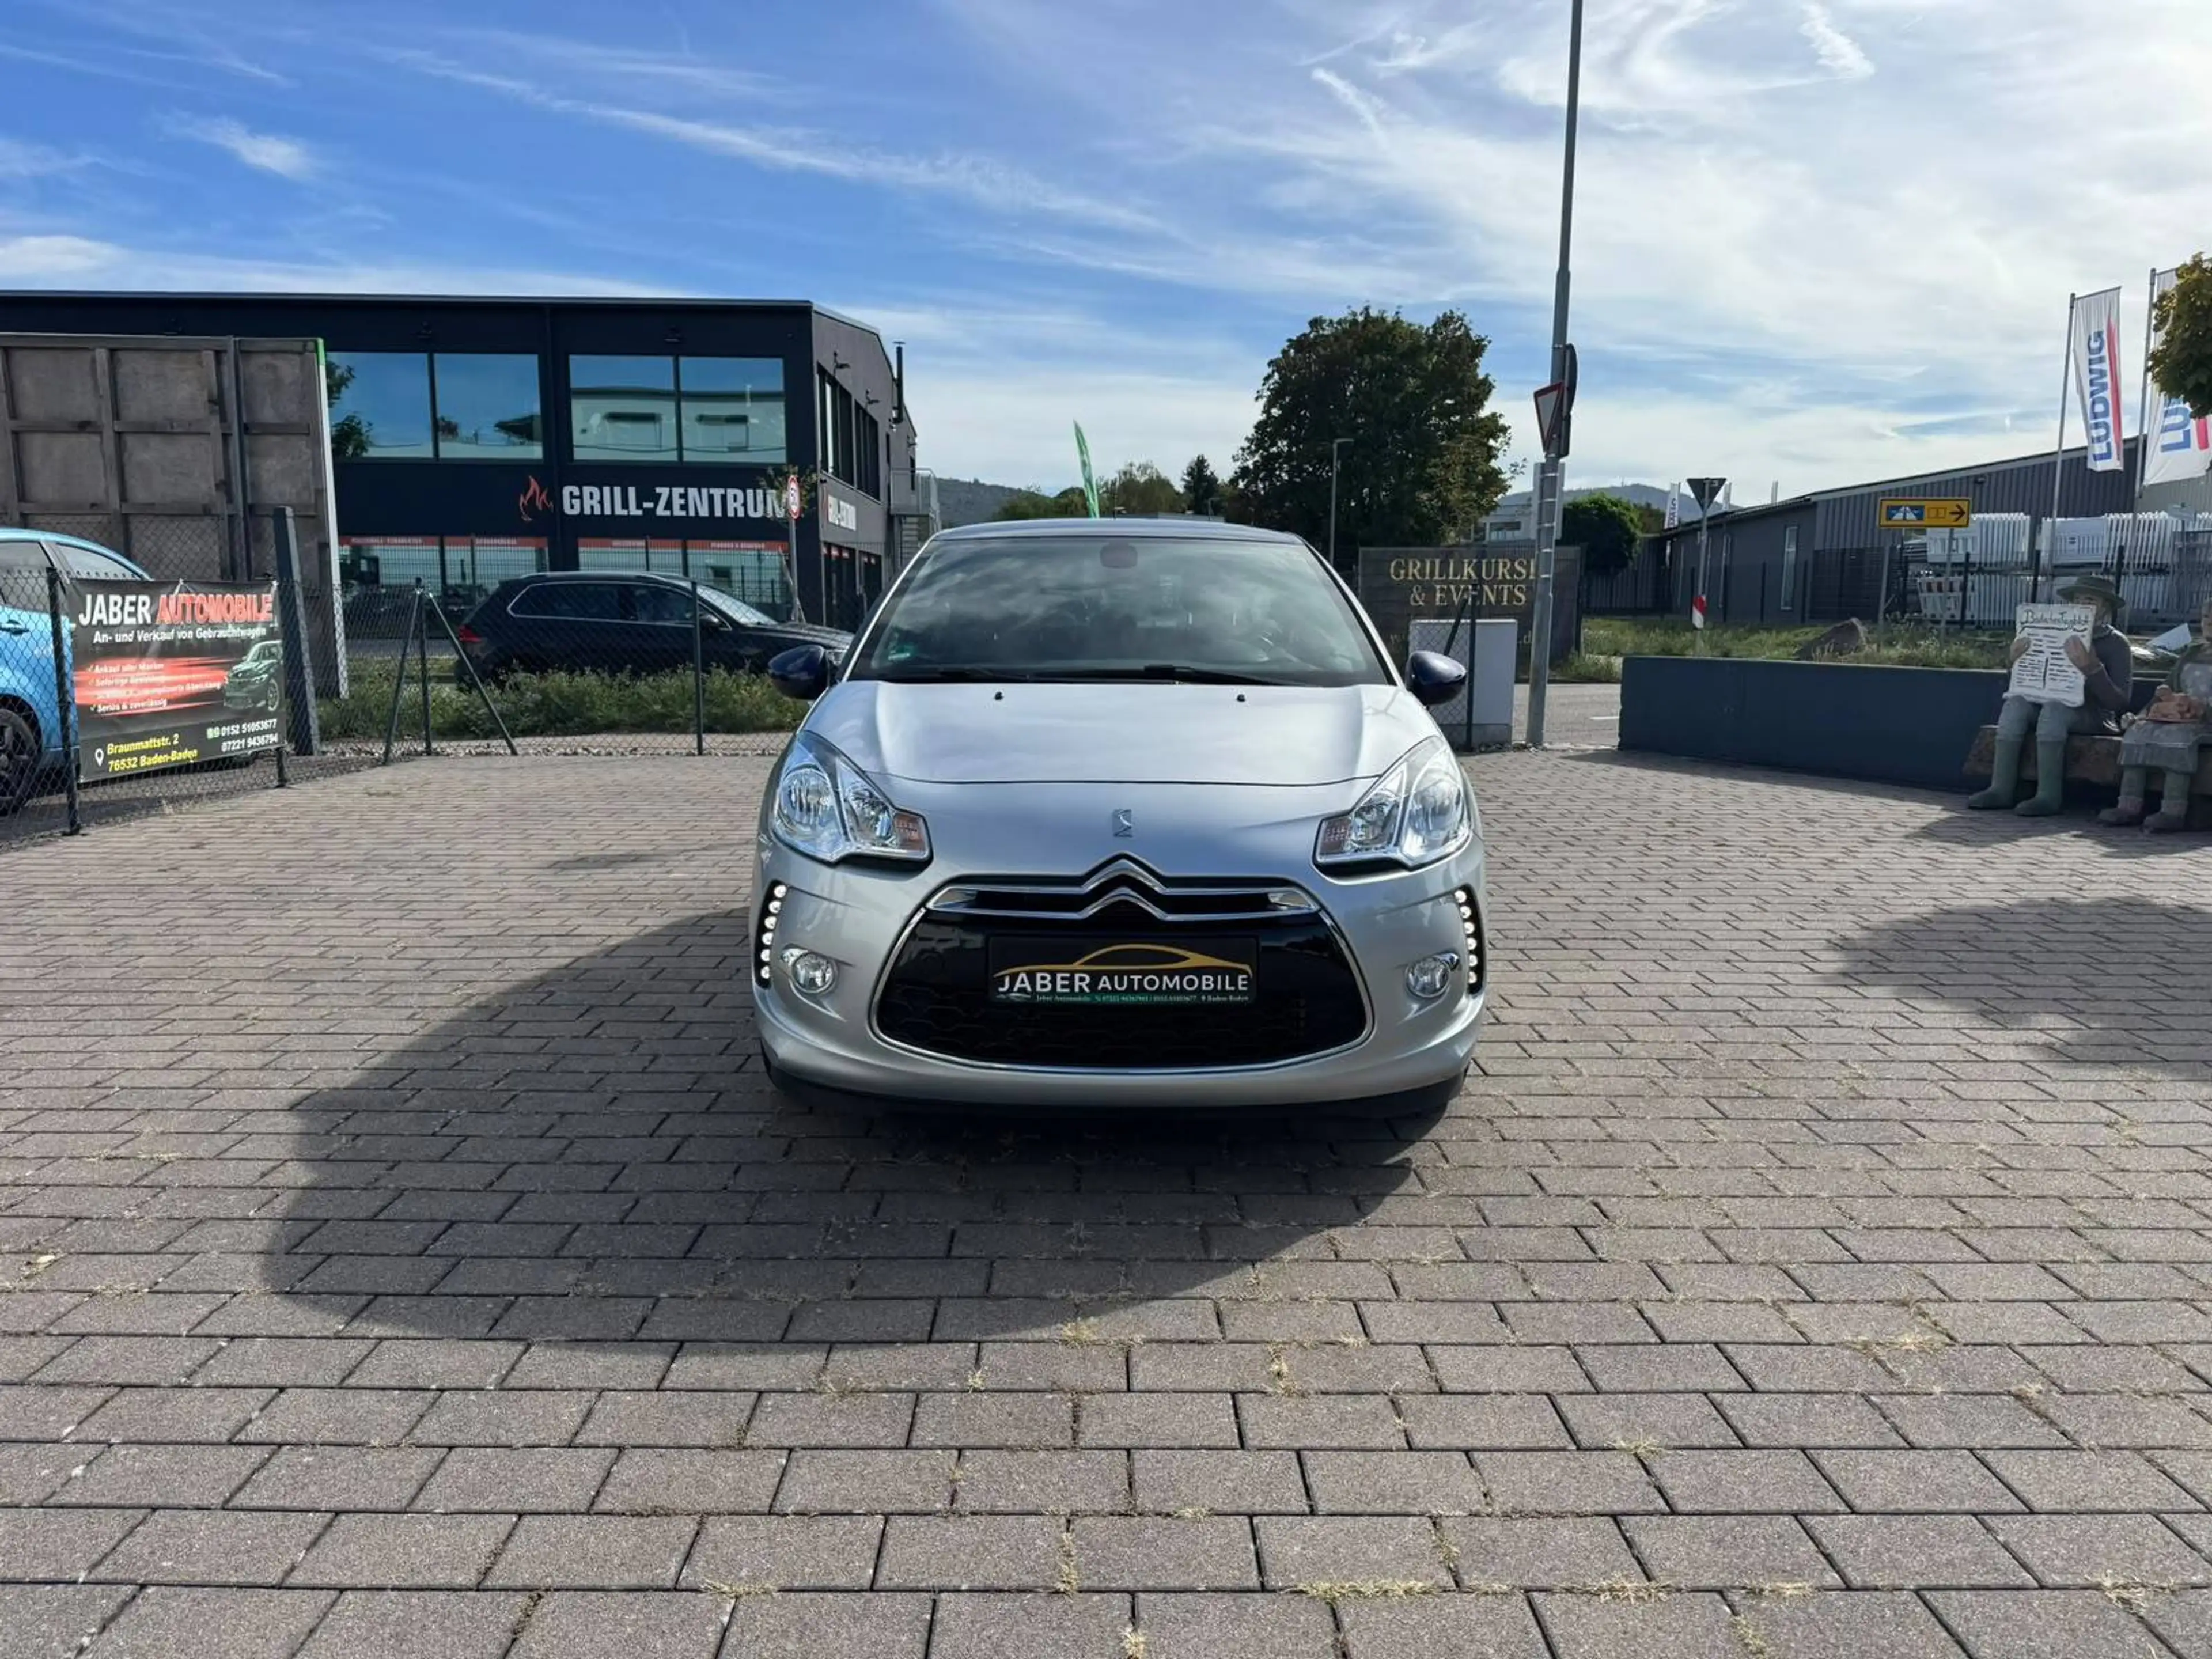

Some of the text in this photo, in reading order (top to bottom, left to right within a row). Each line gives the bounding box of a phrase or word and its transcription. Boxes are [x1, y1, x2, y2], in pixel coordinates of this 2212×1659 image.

[2088, 330, 2112, 463] LUDWIG
[1410, 584, 1527, 605] & EVENTS
[78, 593, 274, 627] JABER AUTOMOBILE
[93, 625, 266, 643] An- und Verkauf von Gebrauchtwagen
[107, 733, 179, 755] Braunmattstr. 2
[108, 749, 198, 772] 76532 Baden-Baden
[998, 972, 1248, 992] JABER AUTOMOBILE
